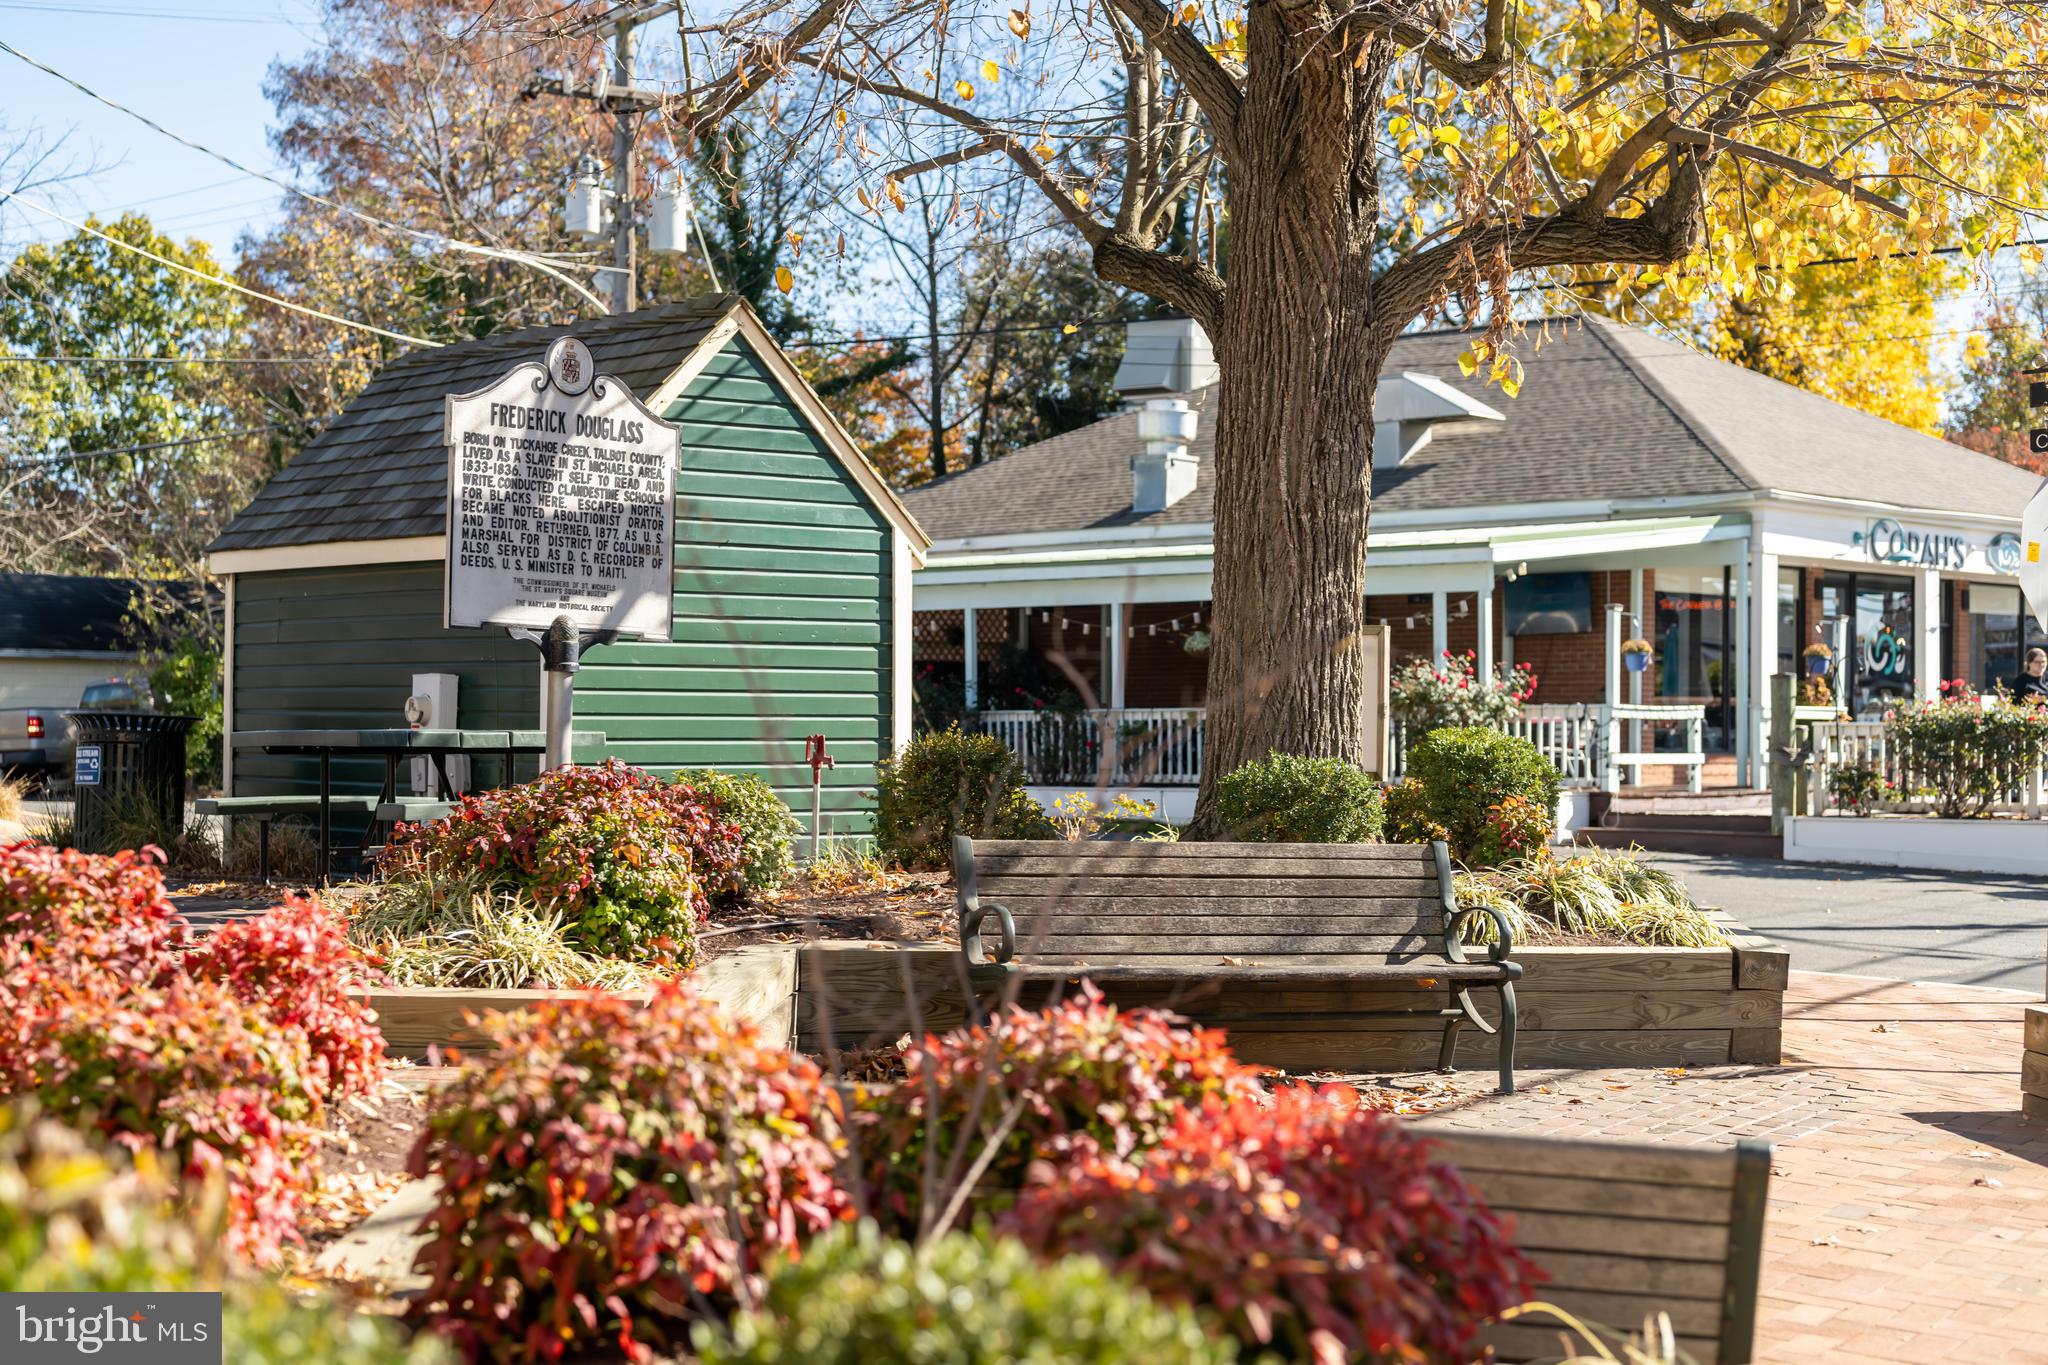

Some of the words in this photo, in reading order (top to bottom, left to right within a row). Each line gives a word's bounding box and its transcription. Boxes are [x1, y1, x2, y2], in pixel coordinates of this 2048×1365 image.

[490, 402, 566, 434] FREDERICK
[576, 414, 644, 444] DOUGLASS
[463, 431, 490, 446] BORN
[493, 435, 506, 448] ON
[510, 437, 558, 454] TUCKAHOE
[593, 447, 626, 463] TALBOT
[463, 445, 493, 460] LIVED
[497, 449, 510, 463] AS
[513, 452, 521, 463] A
[525, 452, 555, 467] SLAVE
[558, 456, 568, 470] IN
[573, 459, 586, 471] ST.
[589, 460, 634, 477] MICHAELS
[462, 459, 522, 477] 1833-1836.
[526, 466, 564, 482] TAUGHT
[569, 471, 593, 484] SELF
[598, 474, 609, 487] TO
[614, 477, 640, 490] READ
[645, 480, 665, 493] AND
[462, 487, 483, 499] FOR
[490, 489, 531, 504] BLACKS
[538, 494, 567, 509] HERE.
[577, 498, 624, 514] ESCAPED
[497, 477, 554, 494] CONDUCTED
[558, 483, 620, 501] CLANDESTINE
[623, 490, 665, 506] SCHOOLS
[462, 499, 505, 515] BECAME
[512, 505, 545, 519] NOTED
[553, 509, 621, 527] ABOLITIONIST
[628, 516, 664, 531] ORATOR
[462, 514, 484, 527] AND
[624, 530, 637, 542] AS
[461, 541, 490, 554] ALSO
[497, 544, 540, 559] SERVED
[547, 548, 560, 561] AS
[593, 552, 645, 568] RECORDER
[651, 558, 664, 570] OF
[462, 527, 514, 543] MARSHAL
[520, 532, 540, 546] FOR
[548, 535, 593, 551] DISTRICT
[597, 540, 609, 552] OF
[613, 541, 664, 557] COLUMBIA.
[513, 577, 524, 585] THE
[591, 583, 616, 592] MICHAELS
[528, 560, 575, 576] MINISTER
[581, 564, 593, 577] TO
[598, 566, 627, 580] HAITI.
[515, 599, 525, 607] THE
[528, 600, 557, 609] MARYLAND
[590, 604, 614, 613] SOCIETY
[564, 587, 585, 596] SQUARE
